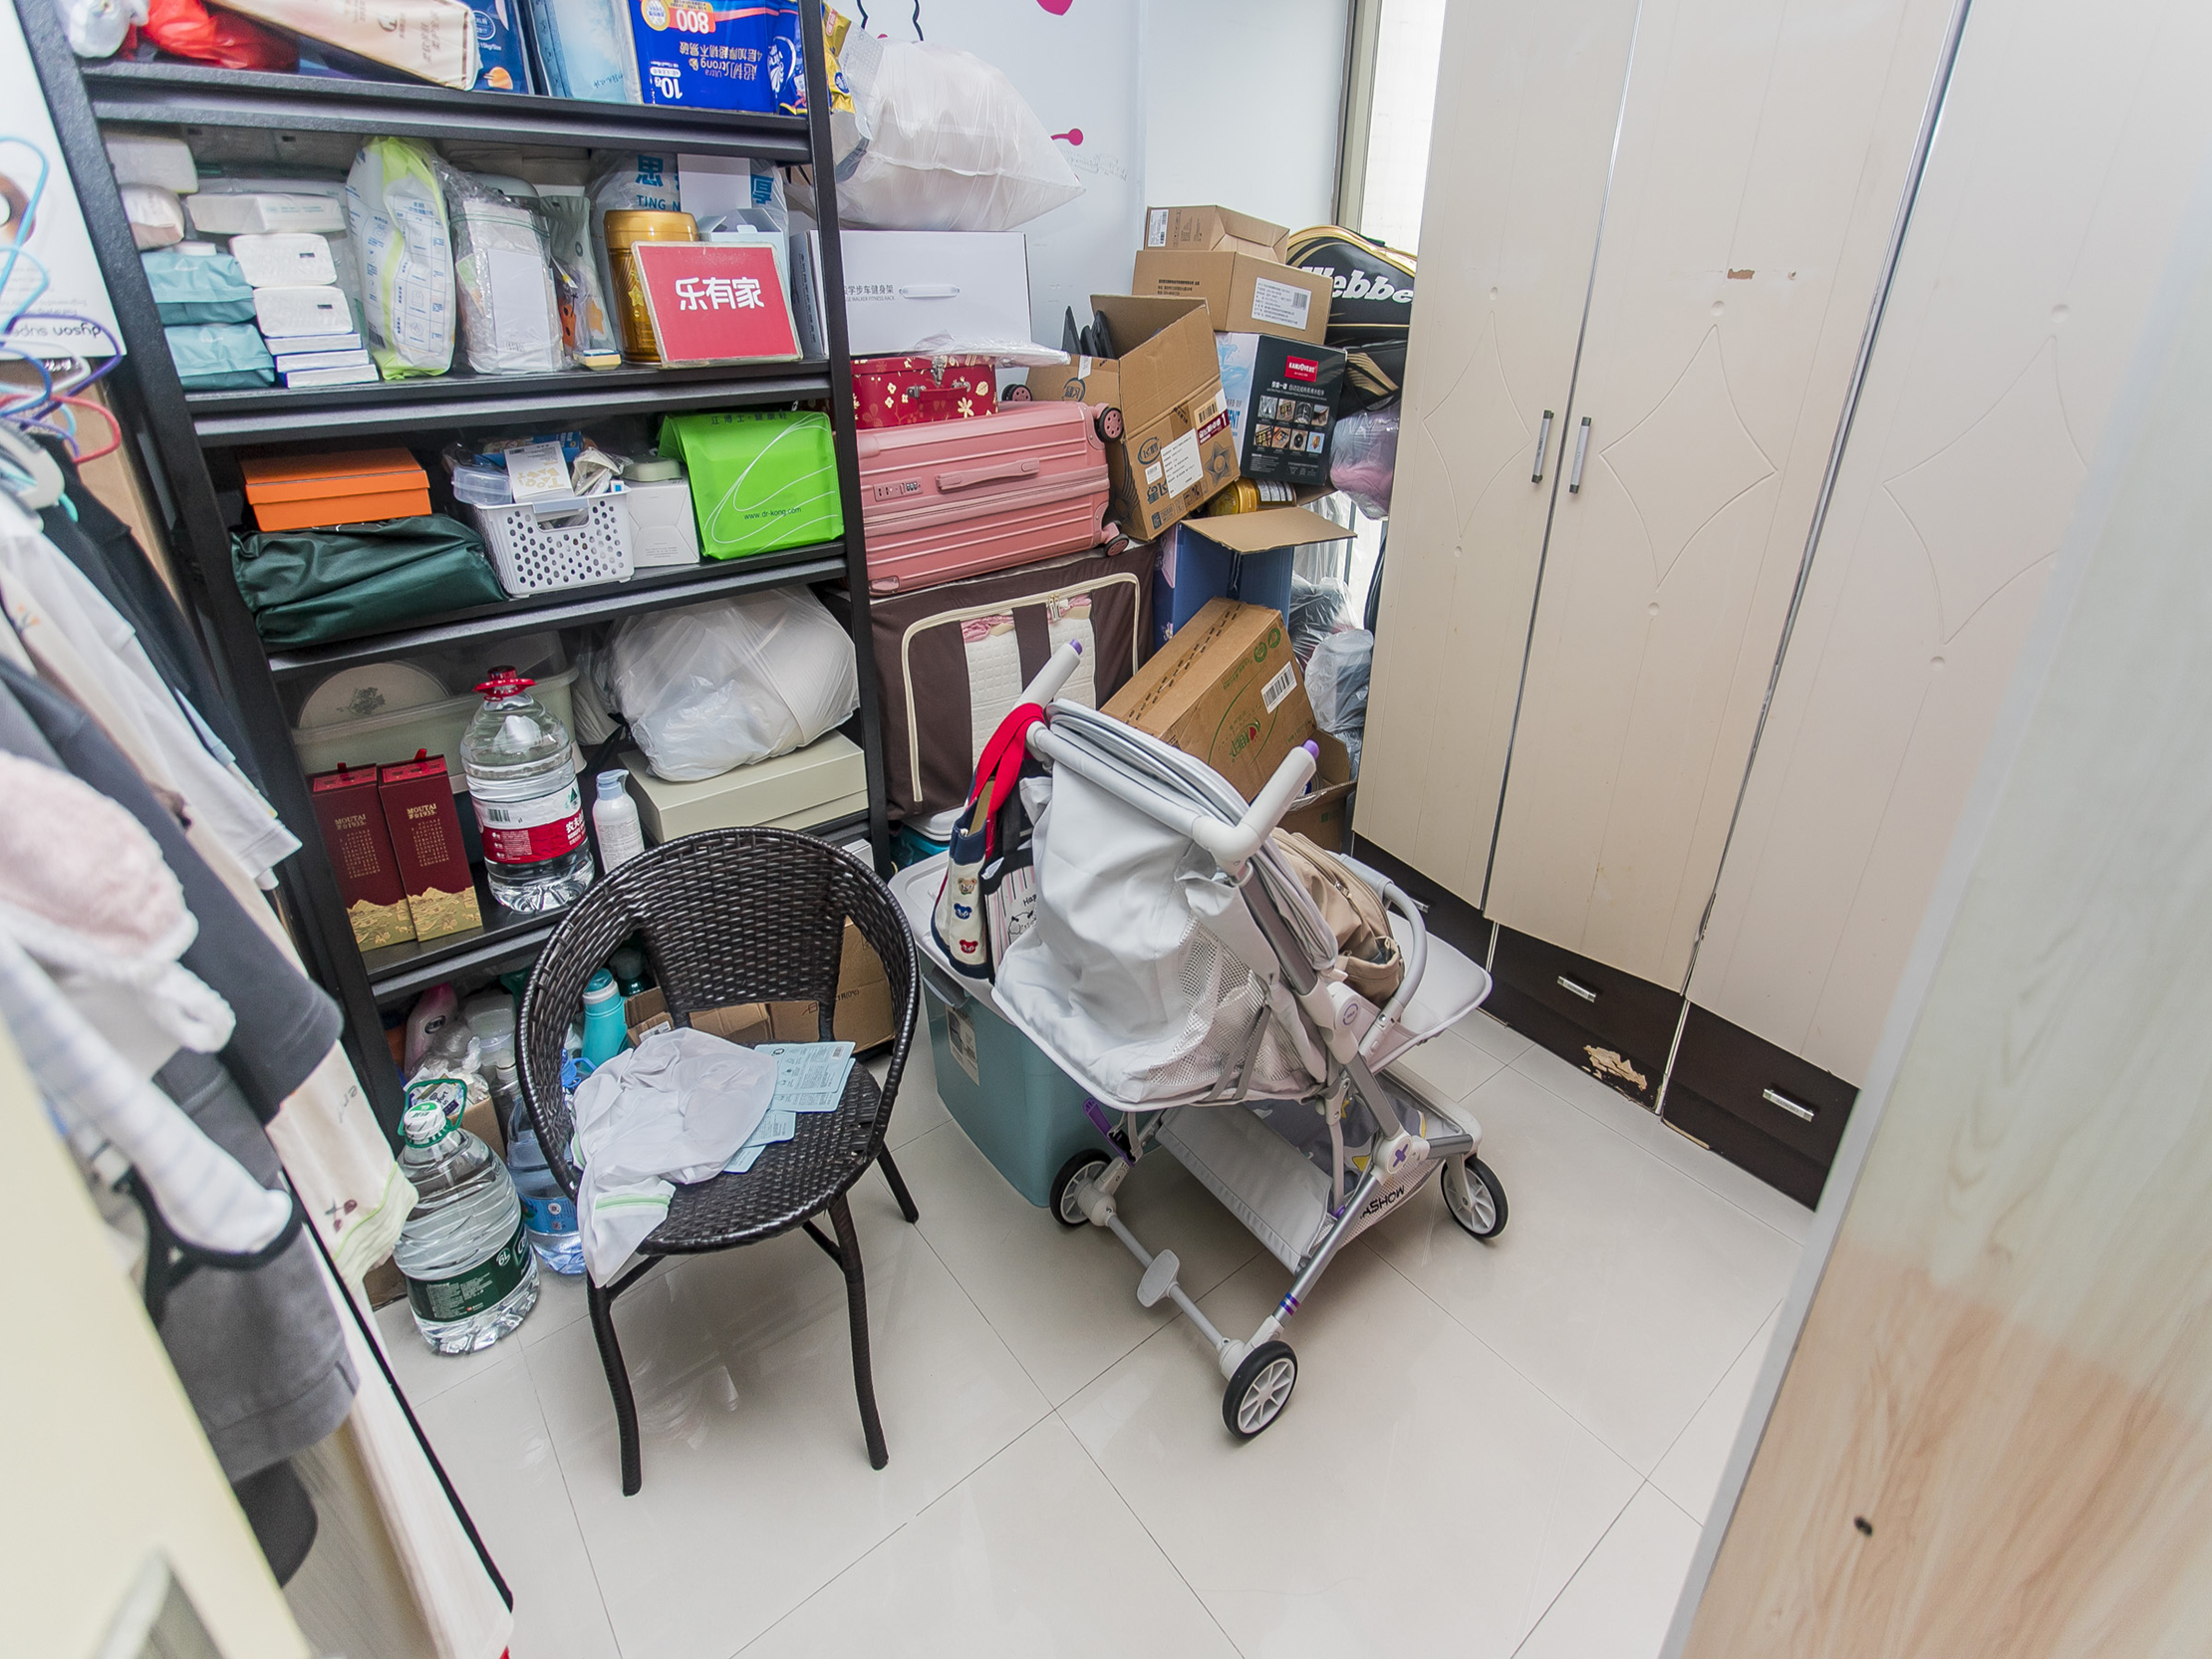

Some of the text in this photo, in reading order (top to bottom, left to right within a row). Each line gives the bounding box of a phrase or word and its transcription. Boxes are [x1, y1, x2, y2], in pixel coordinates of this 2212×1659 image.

[676, 9, 709, 34] 800
[637, 195, 667, 210] TING
[675, 276, 765, 311] 乐有家
[53, 322, 102, 340] dyson
[744, 506, 802, 520] www.dr-kong.com
[407, 803, 437, 815] MOUTAI
[335, 813, 367, 826] MOUTAI
[1022, 893, 1037, 906] Hap
[1359, 1184, 1406, 1220] ASHOW
